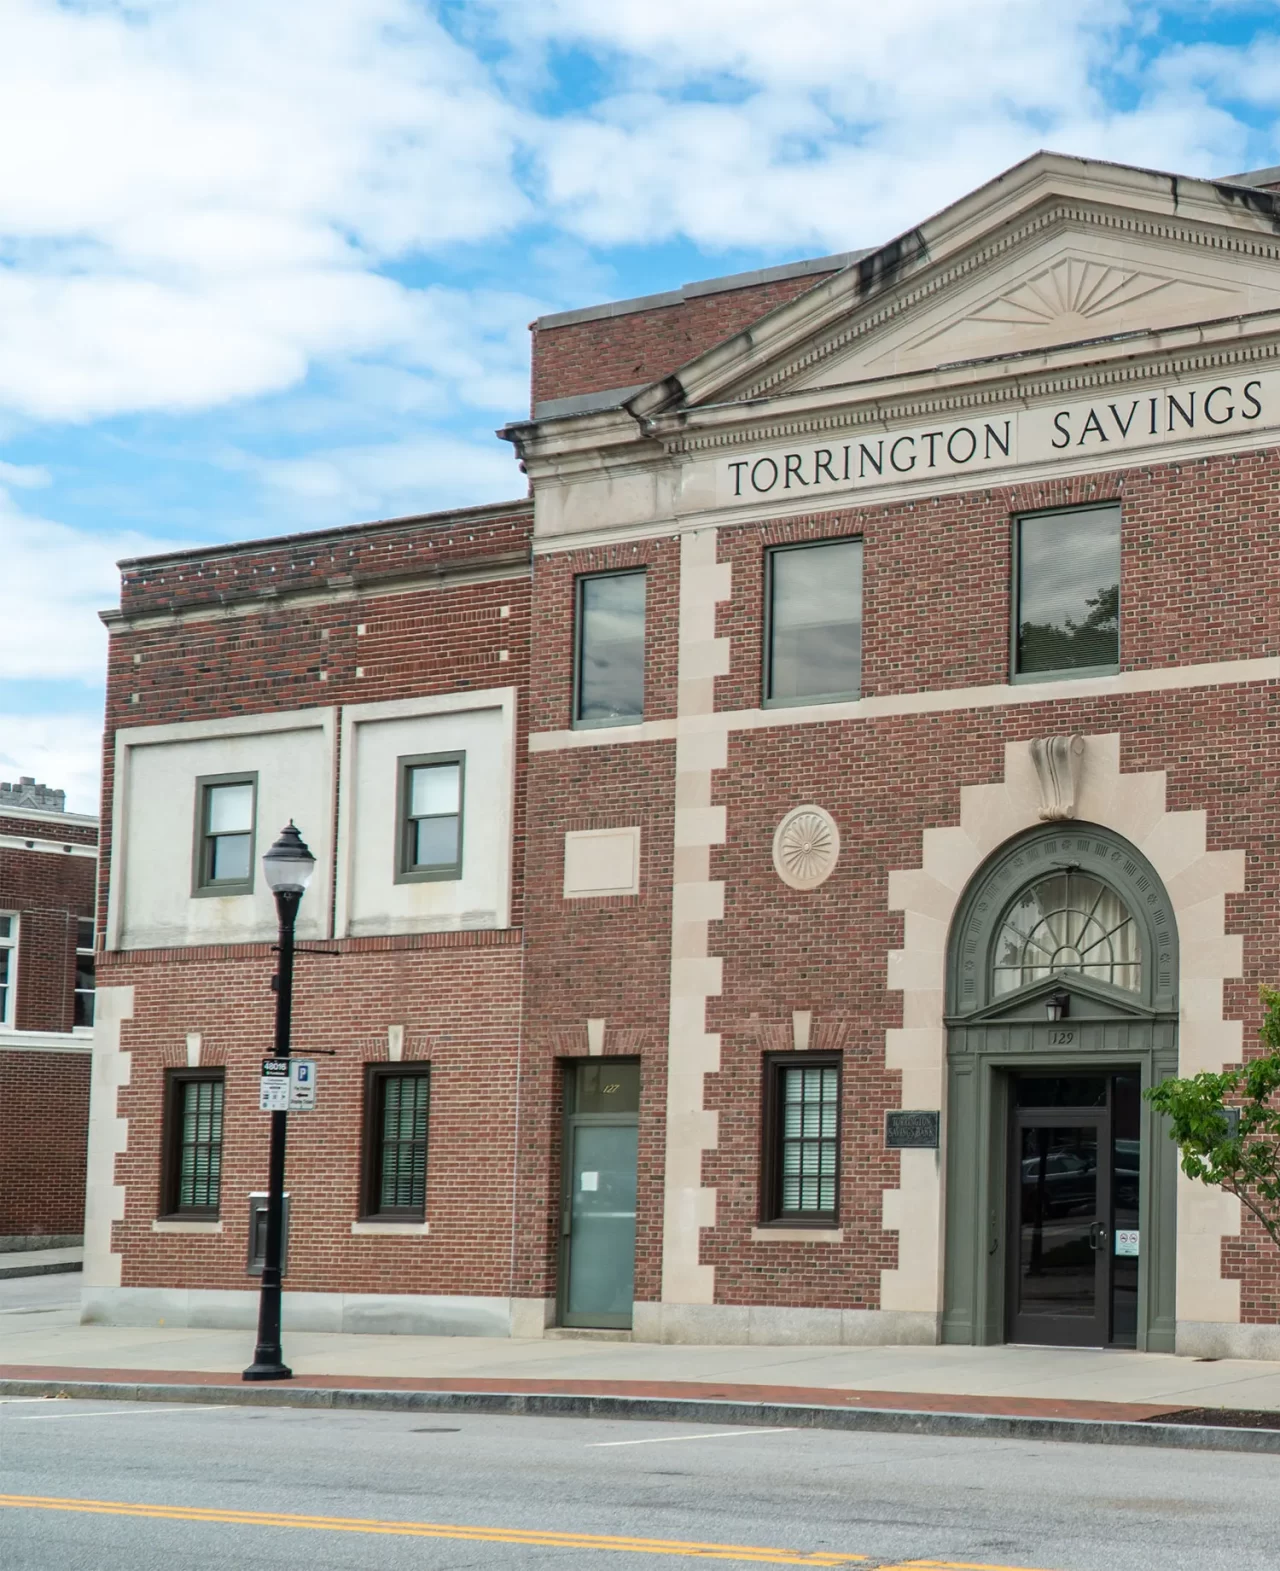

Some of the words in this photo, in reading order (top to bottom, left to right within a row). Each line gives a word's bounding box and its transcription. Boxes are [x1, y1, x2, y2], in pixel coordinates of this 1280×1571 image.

[728, 420, 1011, 496] TORRINGTON
[1051, 380, 1262, 449] SAVINGS
[1052, 1032, 1074, 1045] 129
[300, 1067, 307, 1080] P
[603, 1084, 620, 1093] 127
